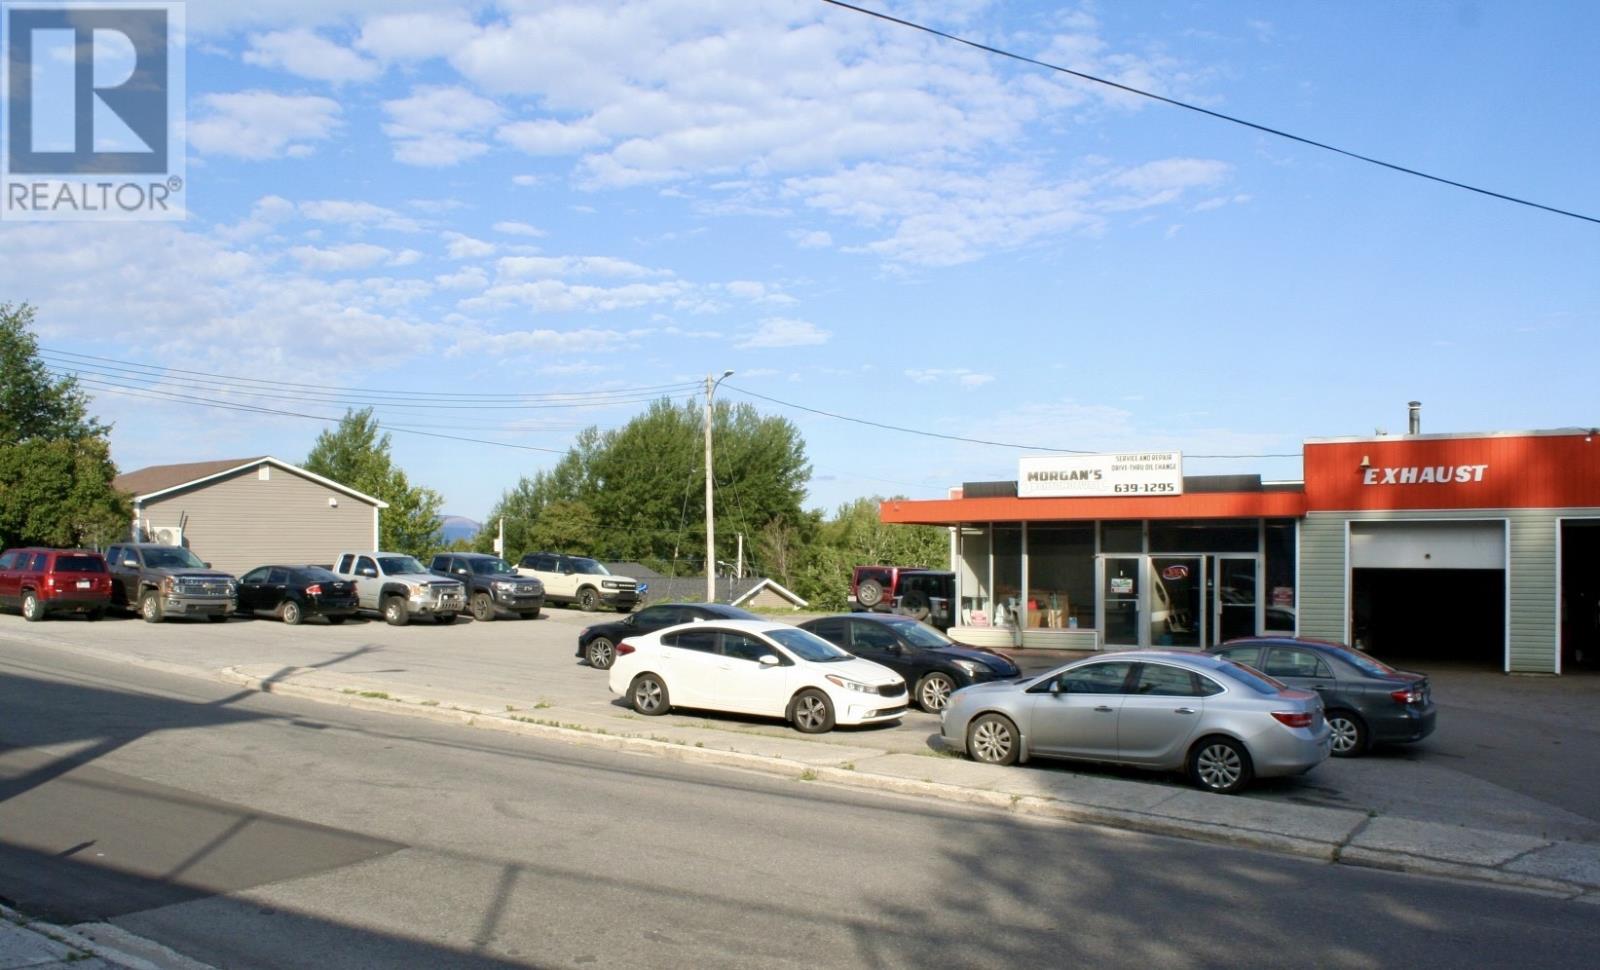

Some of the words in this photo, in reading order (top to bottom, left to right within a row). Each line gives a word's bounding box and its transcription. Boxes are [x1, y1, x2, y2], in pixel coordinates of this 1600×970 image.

[1027, 469, 1102, 482] MORGAN'S
[1363, 464, 1488, 485] EXHAUST
[1114, 483, 1174, 493] 639-1295
